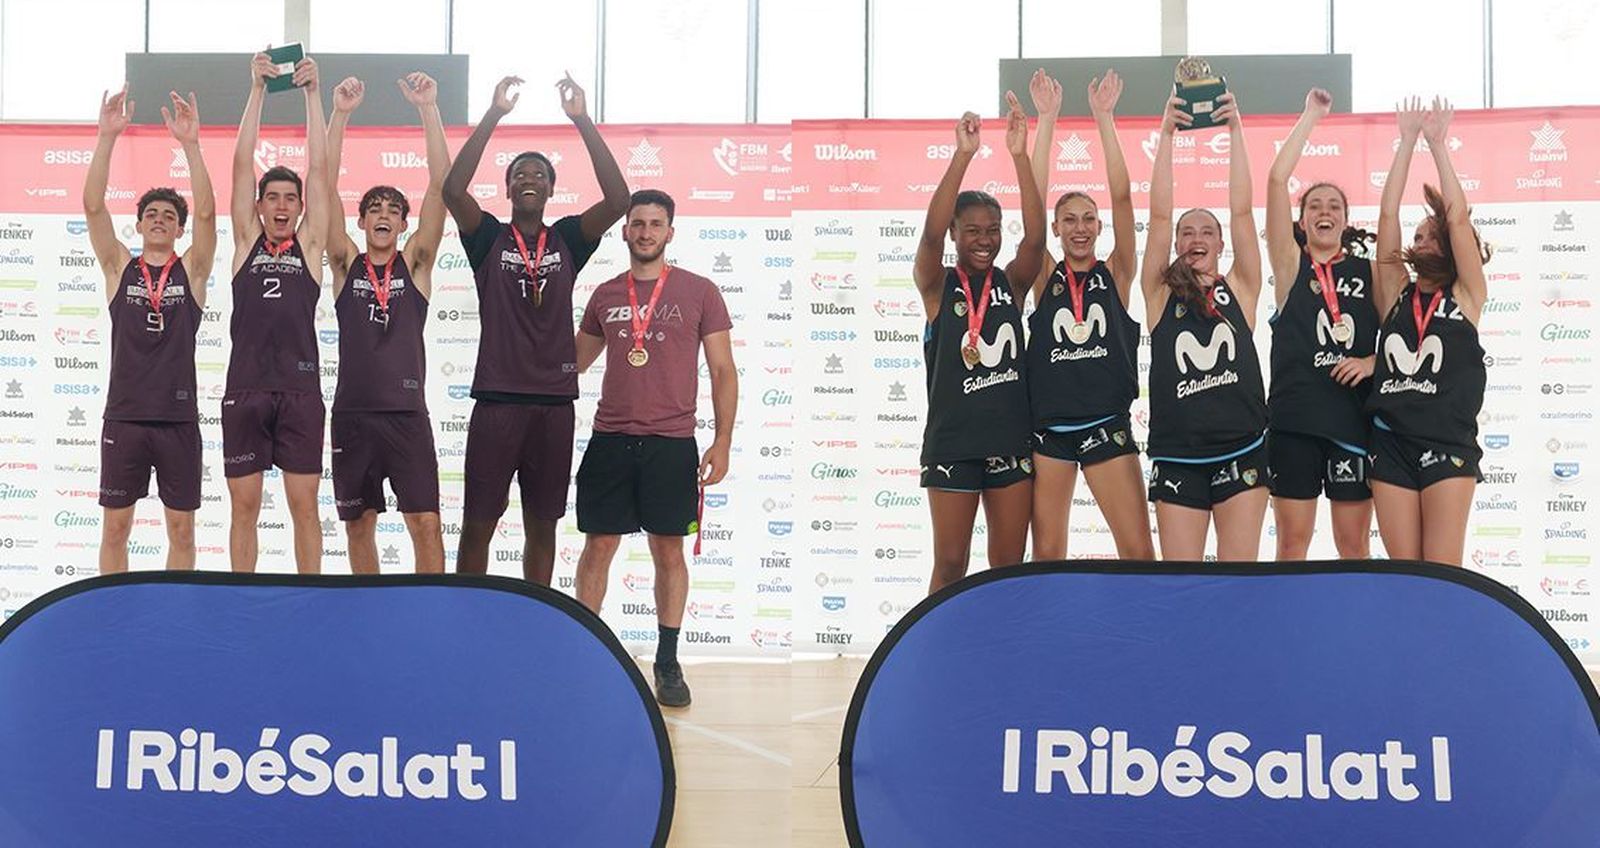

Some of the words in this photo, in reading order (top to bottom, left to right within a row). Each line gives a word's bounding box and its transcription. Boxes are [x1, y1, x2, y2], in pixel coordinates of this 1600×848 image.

[279, 146, 305, 157] FBM
[740, 144, 768, 156] FBM
[814, 144, 877, 161] Wilson
[380, 151, 429, 168] Wils
[1200, 157, 1230, 165] Iberca
[1460, 179, 1481, 191] KEY
[1515, 177, 1562, 189] SPALDING
[547, 192, 579, 204] ENKEY
[815, 226, 853, 236] SPALDING
[879, 227, 917, 238] TENKEY
[60, 257, 96, 267] TENKEY
[764, 256, 792, 267] asis
[58, 282, 96, 292] SPALDING
[262, 278, 283, 298] 2
[1087, 273, 1108, 292] 11
[1336, 276, 1366, 299] 42
[721, 285, 743, 293] Salat
[989, 286, 1014, 307] 14
[1213, 286, 1231, 306] 6
[767, 311, 792, 320] RibéS
[810, 303, 856, 316] Wilson
[202, 312, 222, 322] KEY
[874, 330, 920, 343] Wilson
[1540, 323, 1592, 342] Ginos
[1050, 345, 1108, 363] Estudiantes
[54, 357, 99, 370] Wilson
[963, 368, 1019, 395] Estudiantes
[1176, 369, 1239, 399] Estudiantes
[1380, 377, 1437, 395] Estudiantes
[814, 386, 855, 395] RibéSalat
[762, 389, 792, 407] Gin
[877, 414, 918, 422] RibéSalat
[56, 437, 96, 446] RibéSalat
[811, 462, 858, 480] Ginos
[1484, 472, 1518, 484] ENKEY
[874, 490, 922, 508] Ginos
[1475, 500, 1518, 511] SPALDING
[1546, 500, 1588, 512] TENKEY
[54, 510, 100, 528] Ginos
[702, 530, 734, 541] ENKEY
[1544, 528, 1587, 540] SPALDING
[760, 557, 792, 568] TENKE
[757, 584, 792, 594] SPALDIN
[686, 631, 731, 644] Wilson
[815, 632, 853, 644] TENKEY
